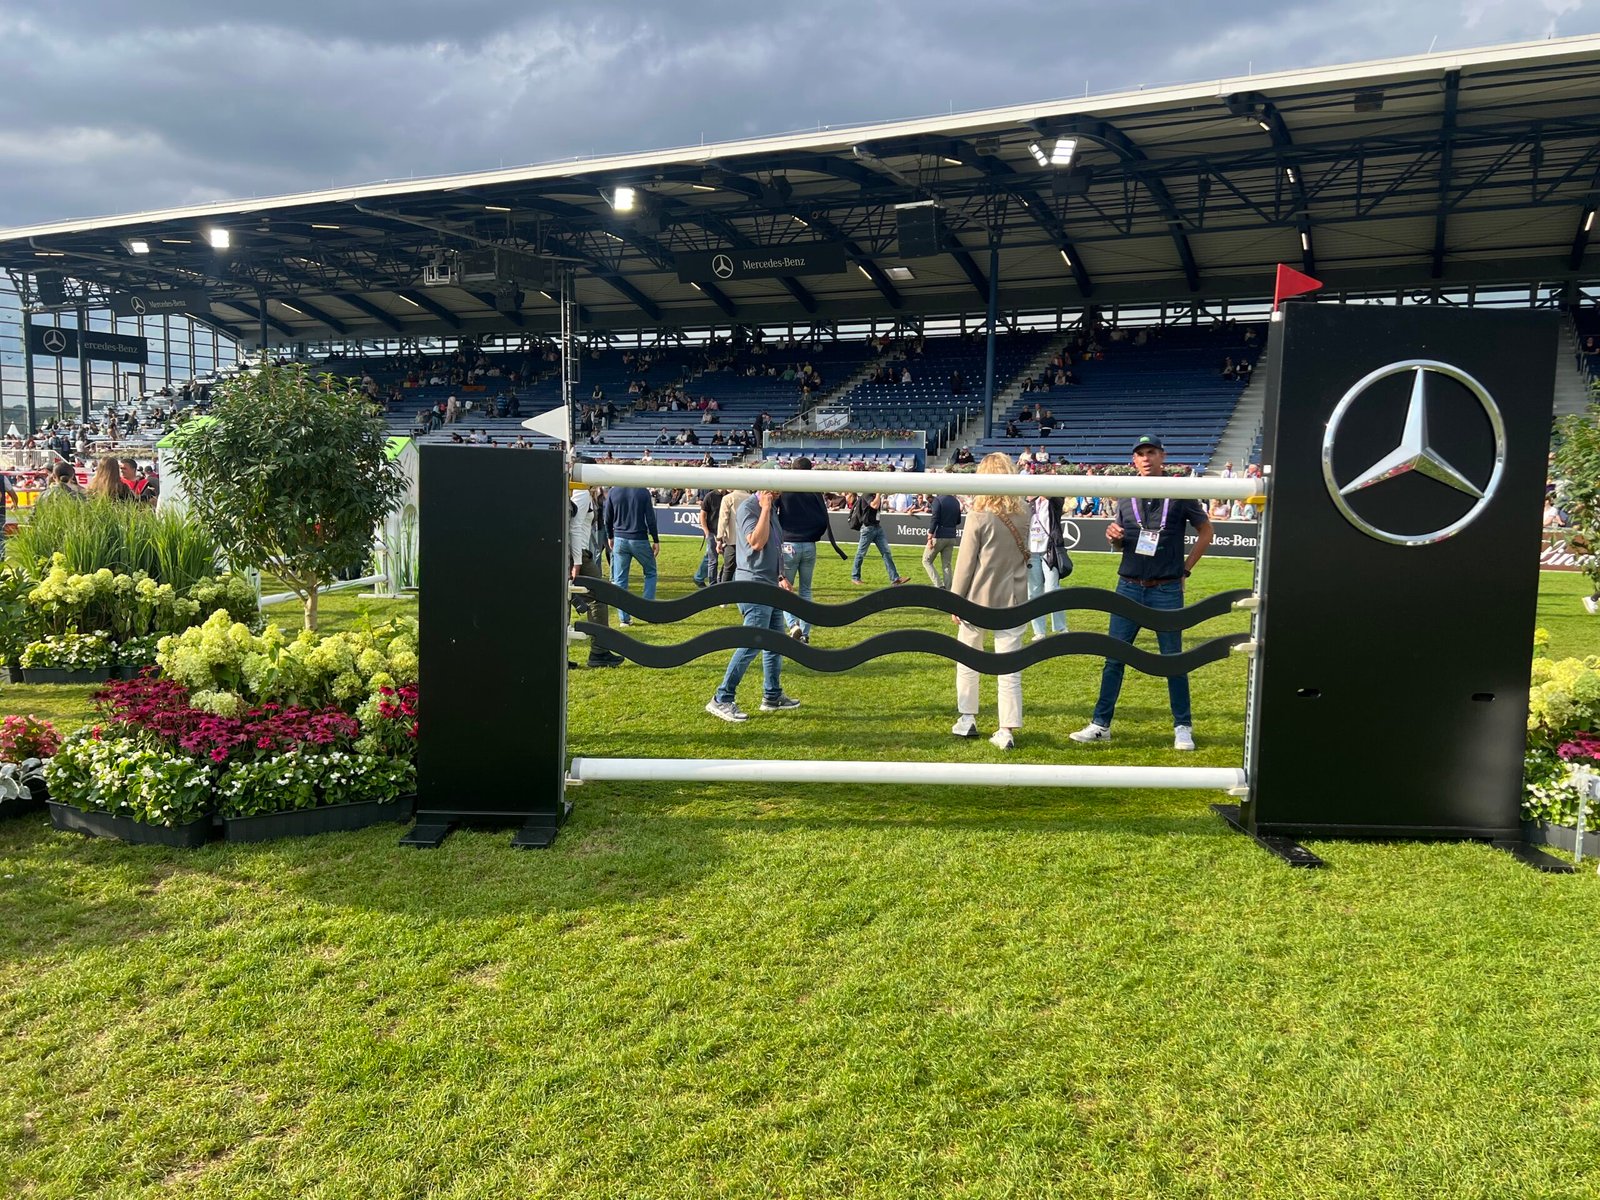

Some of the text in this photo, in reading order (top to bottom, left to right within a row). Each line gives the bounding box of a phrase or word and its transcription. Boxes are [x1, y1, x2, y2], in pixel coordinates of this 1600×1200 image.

[742, 257, 806, 269] Mercedes-Benz
[149, 299, 187, 309] Mercedes-Benz
[84, 341, 138, 353] ercedes-Benz
